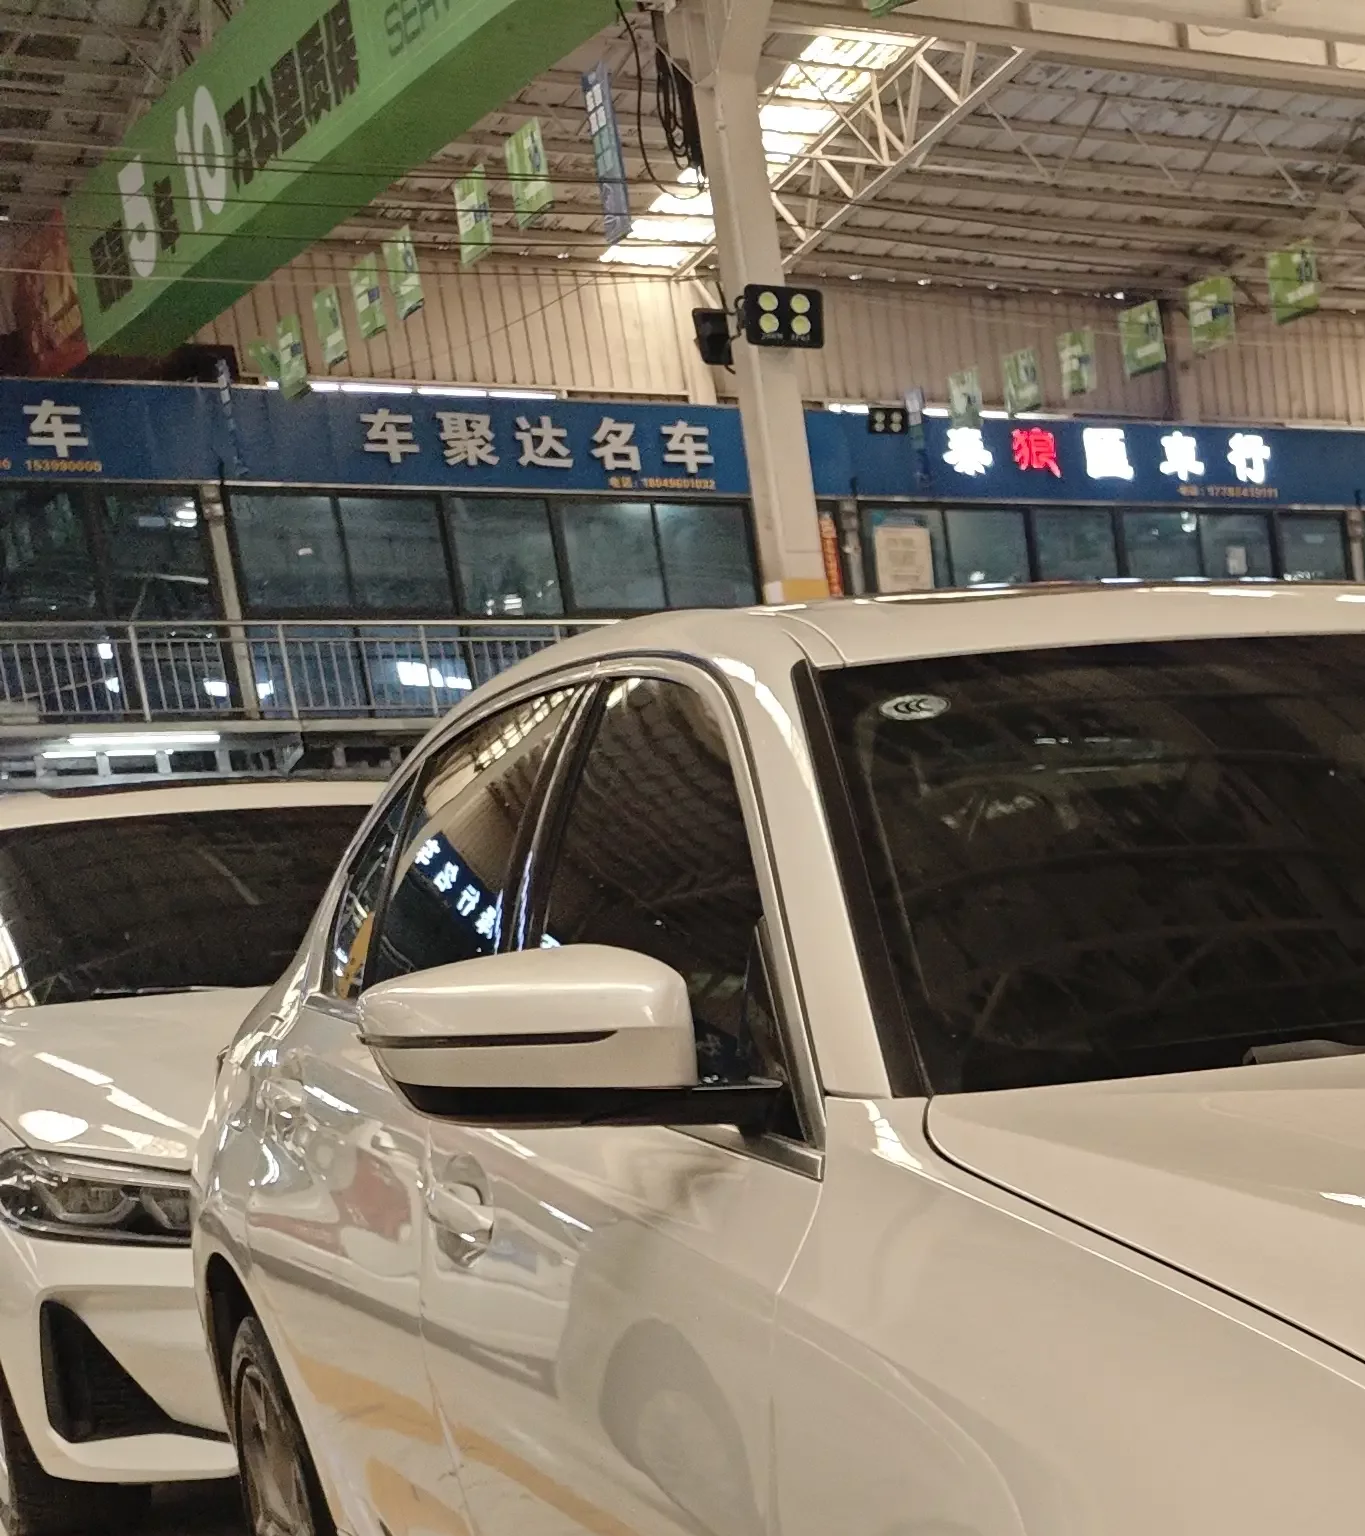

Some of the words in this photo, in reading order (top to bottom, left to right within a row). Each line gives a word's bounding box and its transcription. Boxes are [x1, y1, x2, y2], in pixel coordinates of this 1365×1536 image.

[23, 399, 89, 458] 车
[360, 408, 715, 474] 车聚达名车
